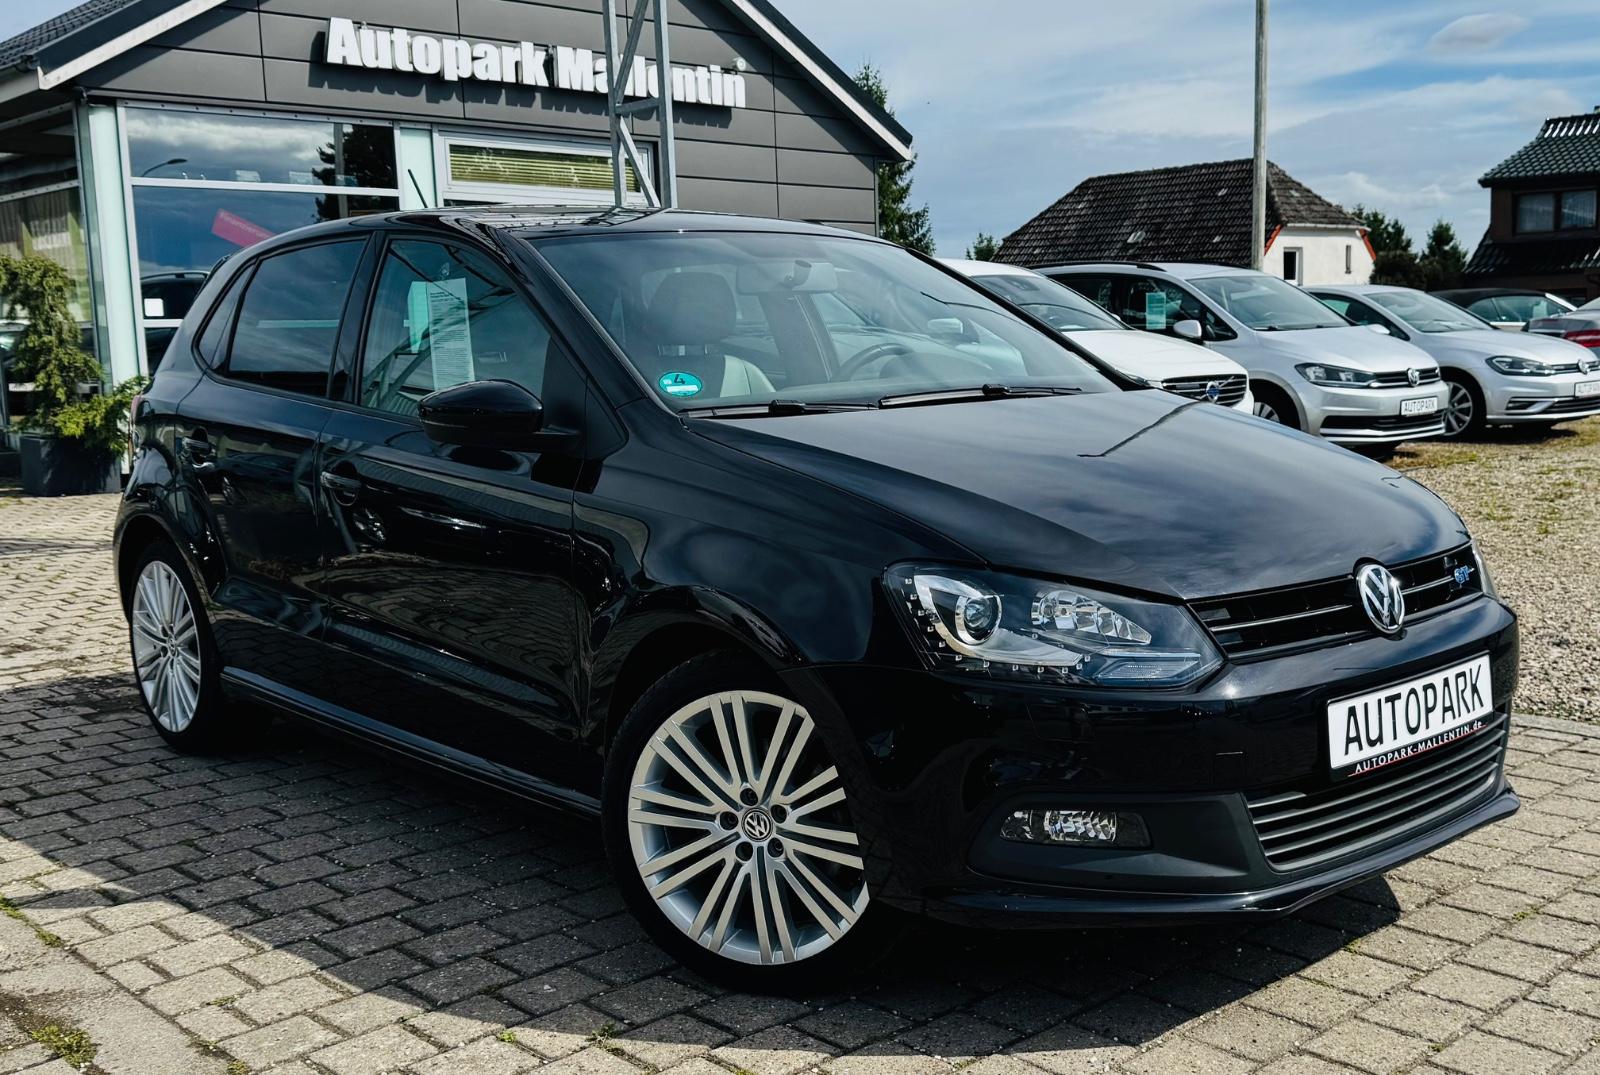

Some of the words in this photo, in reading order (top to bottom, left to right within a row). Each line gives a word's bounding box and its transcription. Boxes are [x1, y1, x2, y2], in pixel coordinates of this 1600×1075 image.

[326, 16, 549, 87] Autopark
[673, 373, 686, 385] 4
[1403, 399, 1436, 413] AUTOPARK
[1358, 563, 1405, 634] VW
[1344, 663, 1485, 756] AUTOPARK
[1355, 719, 1483, 774] AUTOPARK-MALLENTIN.de
[744, 811, 771, 839] VW
